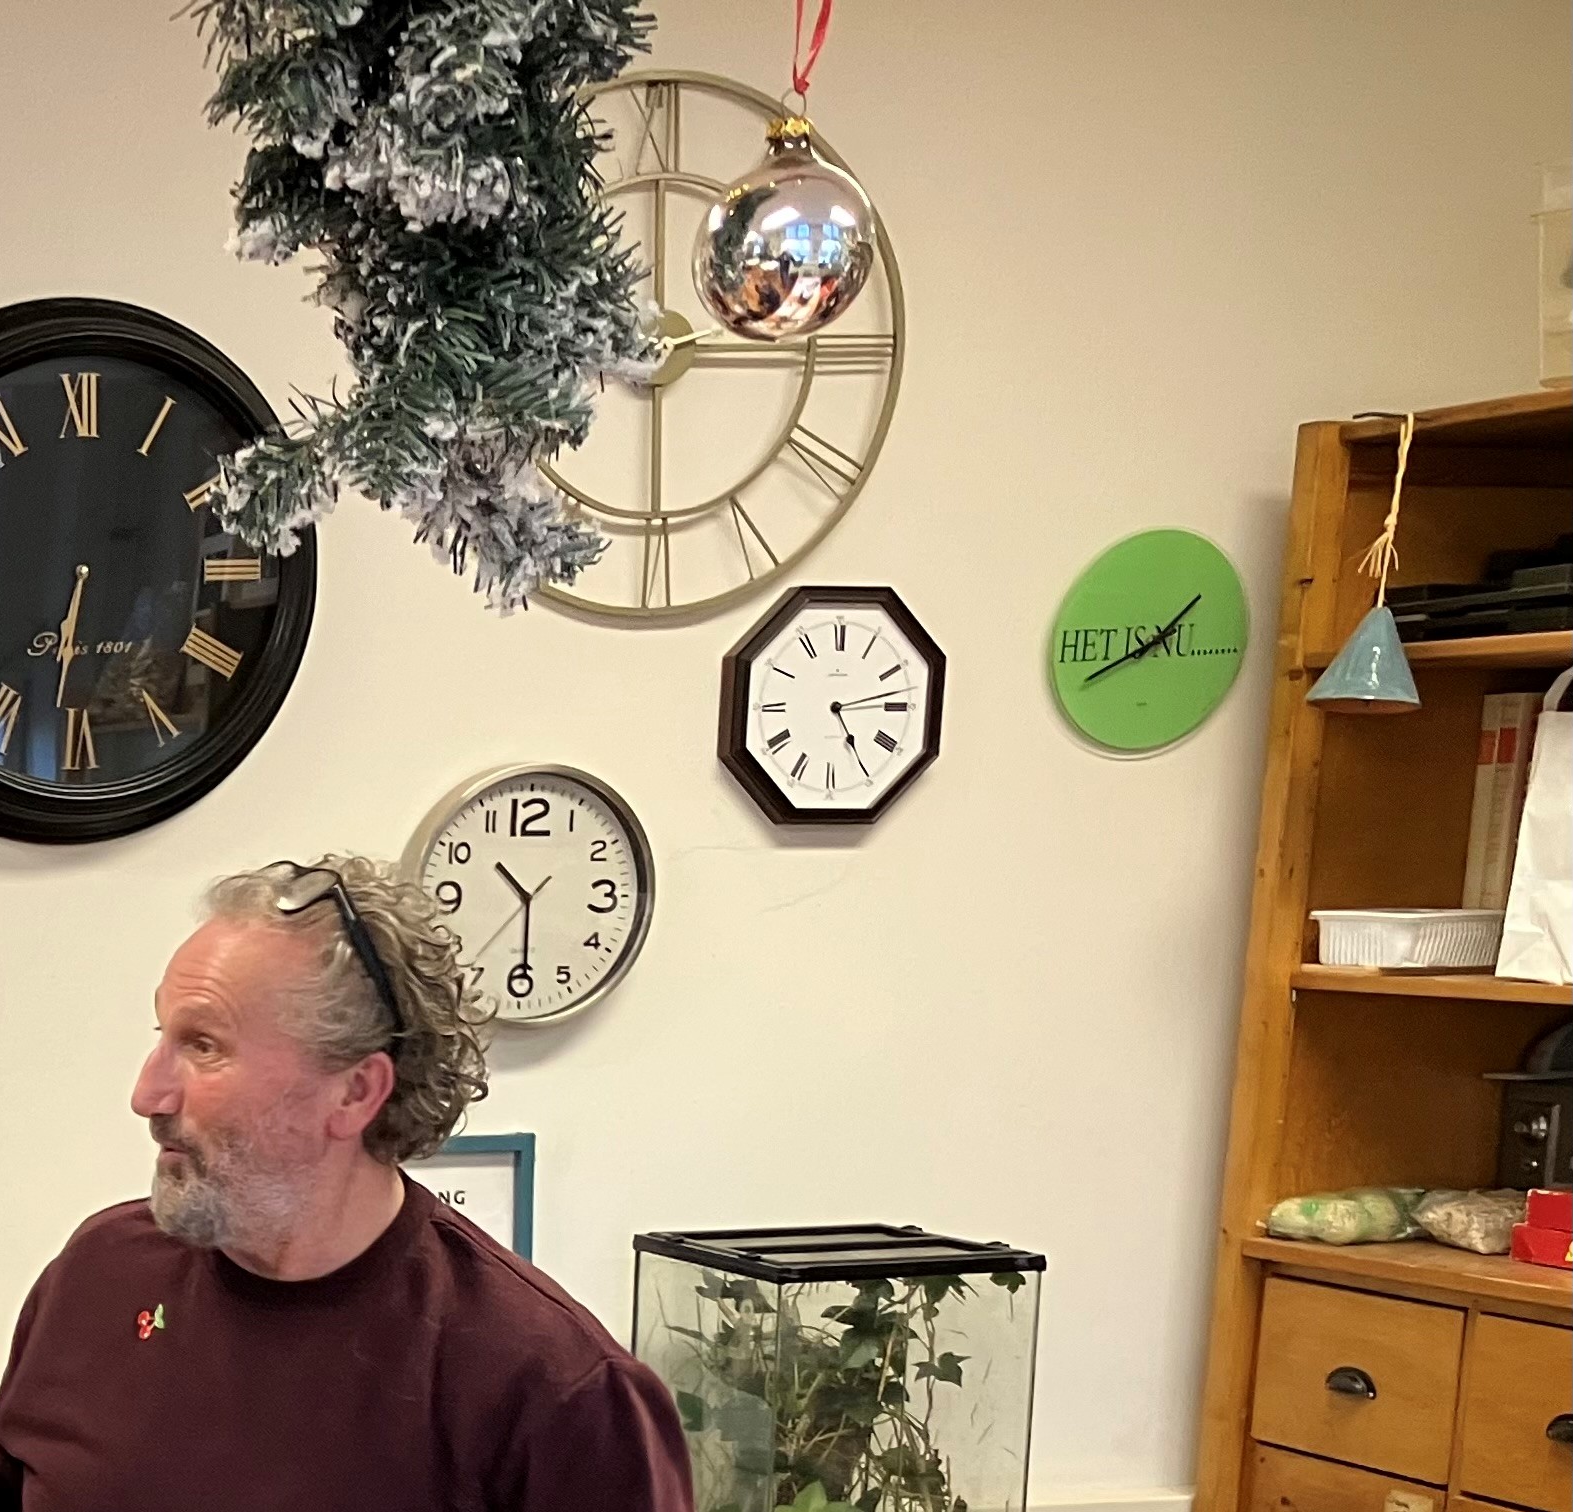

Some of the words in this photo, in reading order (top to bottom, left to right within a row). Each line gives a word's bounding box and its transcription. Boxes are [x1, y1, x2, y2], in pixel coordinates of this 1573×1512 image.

[59, 372, 101, 439] XII
[204, 558, 261, 583] III
[96, 641, 132, 654] 1801
[1059, 628, 1118, 664] HET
[141, 688, 184, 748] V
[63, 707, 100, 771] VI
[485, 809, 497, 834] 11
[509, 797, 551, 837] 12
[568, 809, 575, 833] 1
[448, 841, 472, 864] 10
[590, 840, 608, 862] 2
[435, 880, 463, 914] 9
[586, 879, 618, 914] 3
[583, 932, 601, 950] 4
[506, 963, 534, 998] 6
[556, 966, 571, 985] 5
